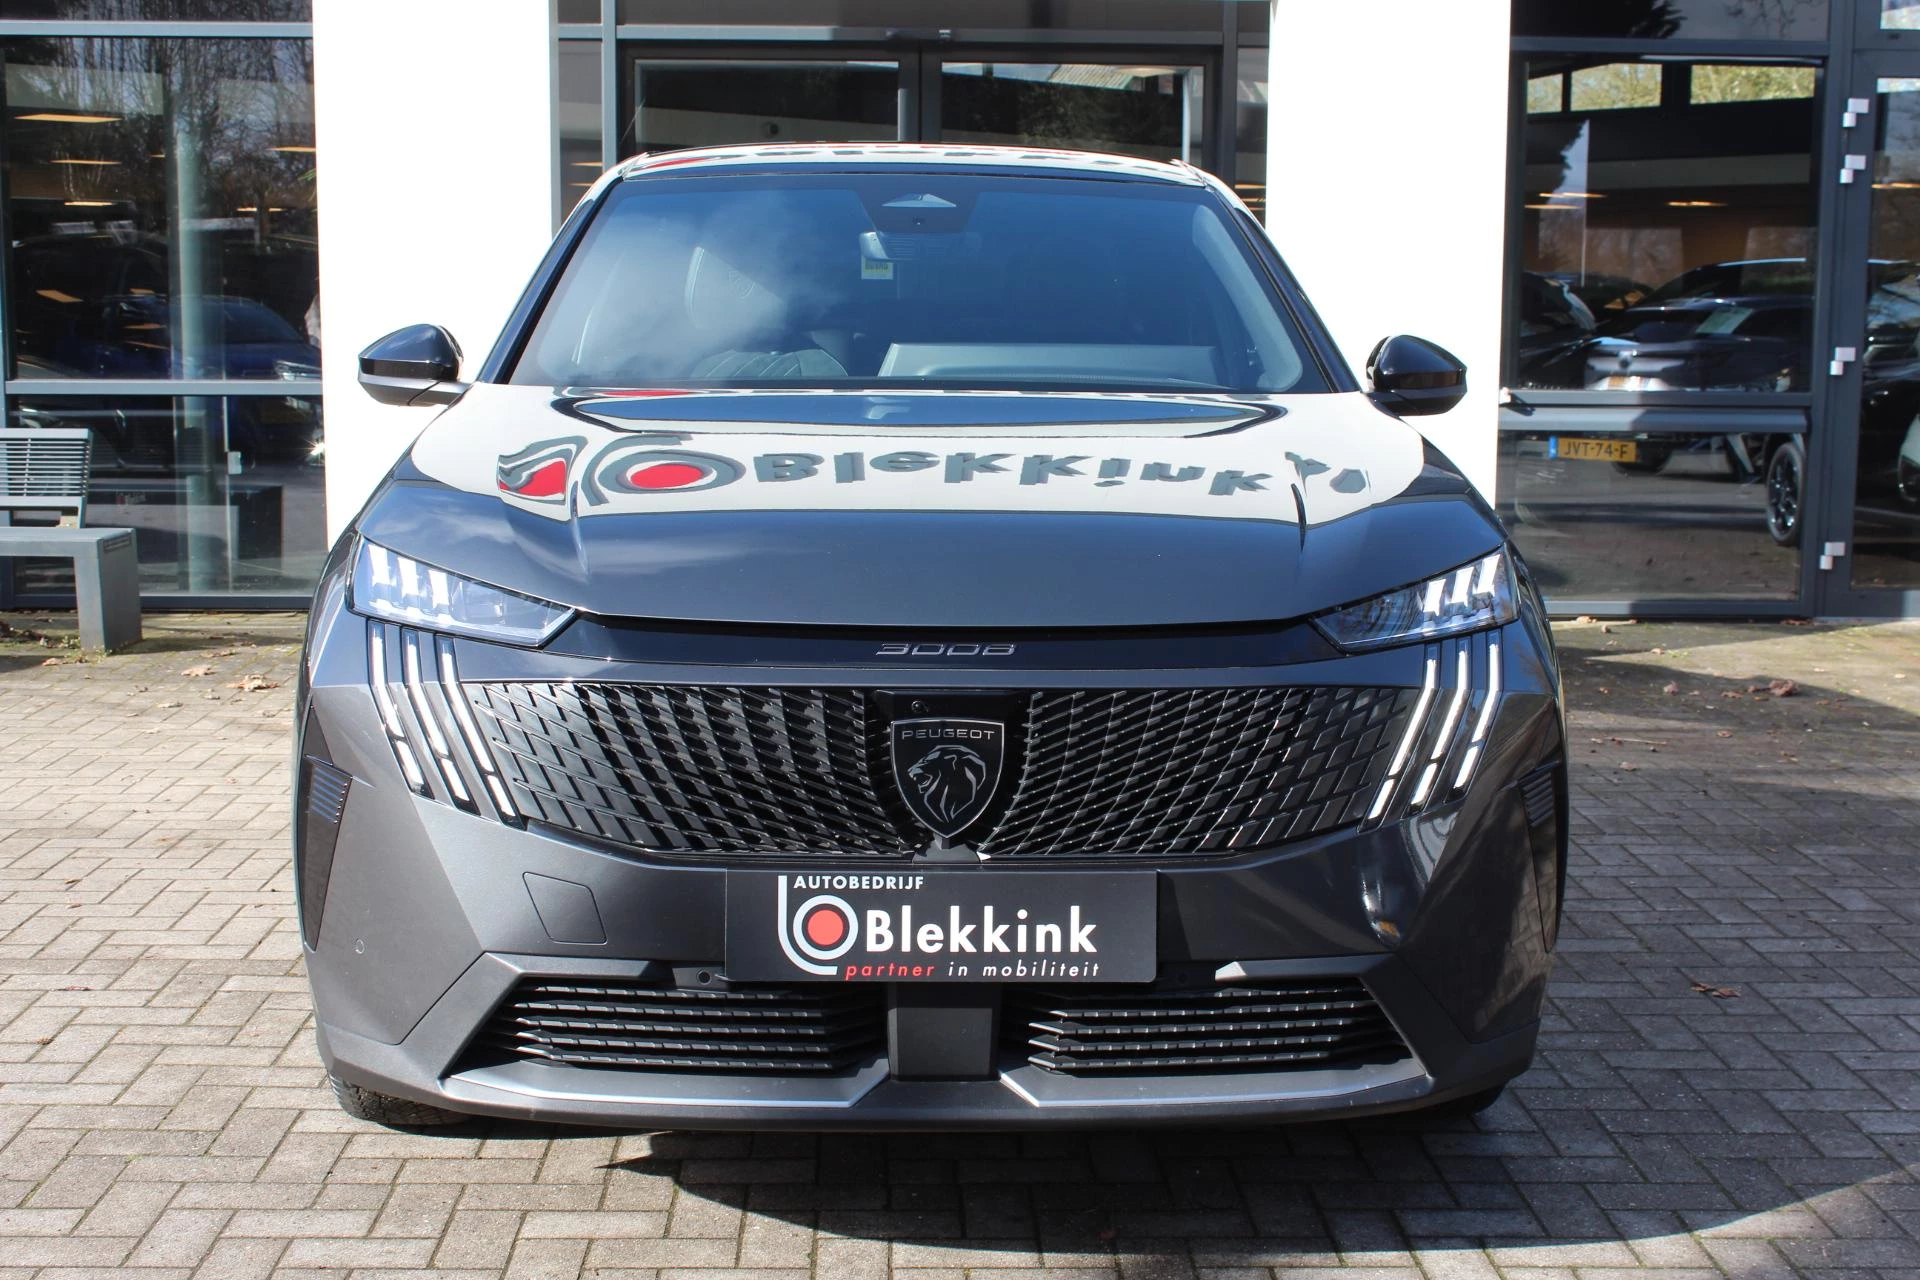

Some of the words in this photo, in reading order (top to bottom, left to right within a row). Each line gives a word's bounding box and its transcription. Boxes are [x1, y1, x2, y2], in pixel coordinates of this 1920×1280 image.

[1564, 442, 1629, 459] JVT-74-F
[875, 643, 1017, 656] 3008
[901, 728, 996, 741] PEUGEOT
[793, 875, 924, 890] AUTOBEDRIJF
[865, 905, 1098, 953] Blekkink
[845, 962, 935, 981] partner
[948, 960, 968, 977] in
[982, 959, 1100, 977] mobiliteit
